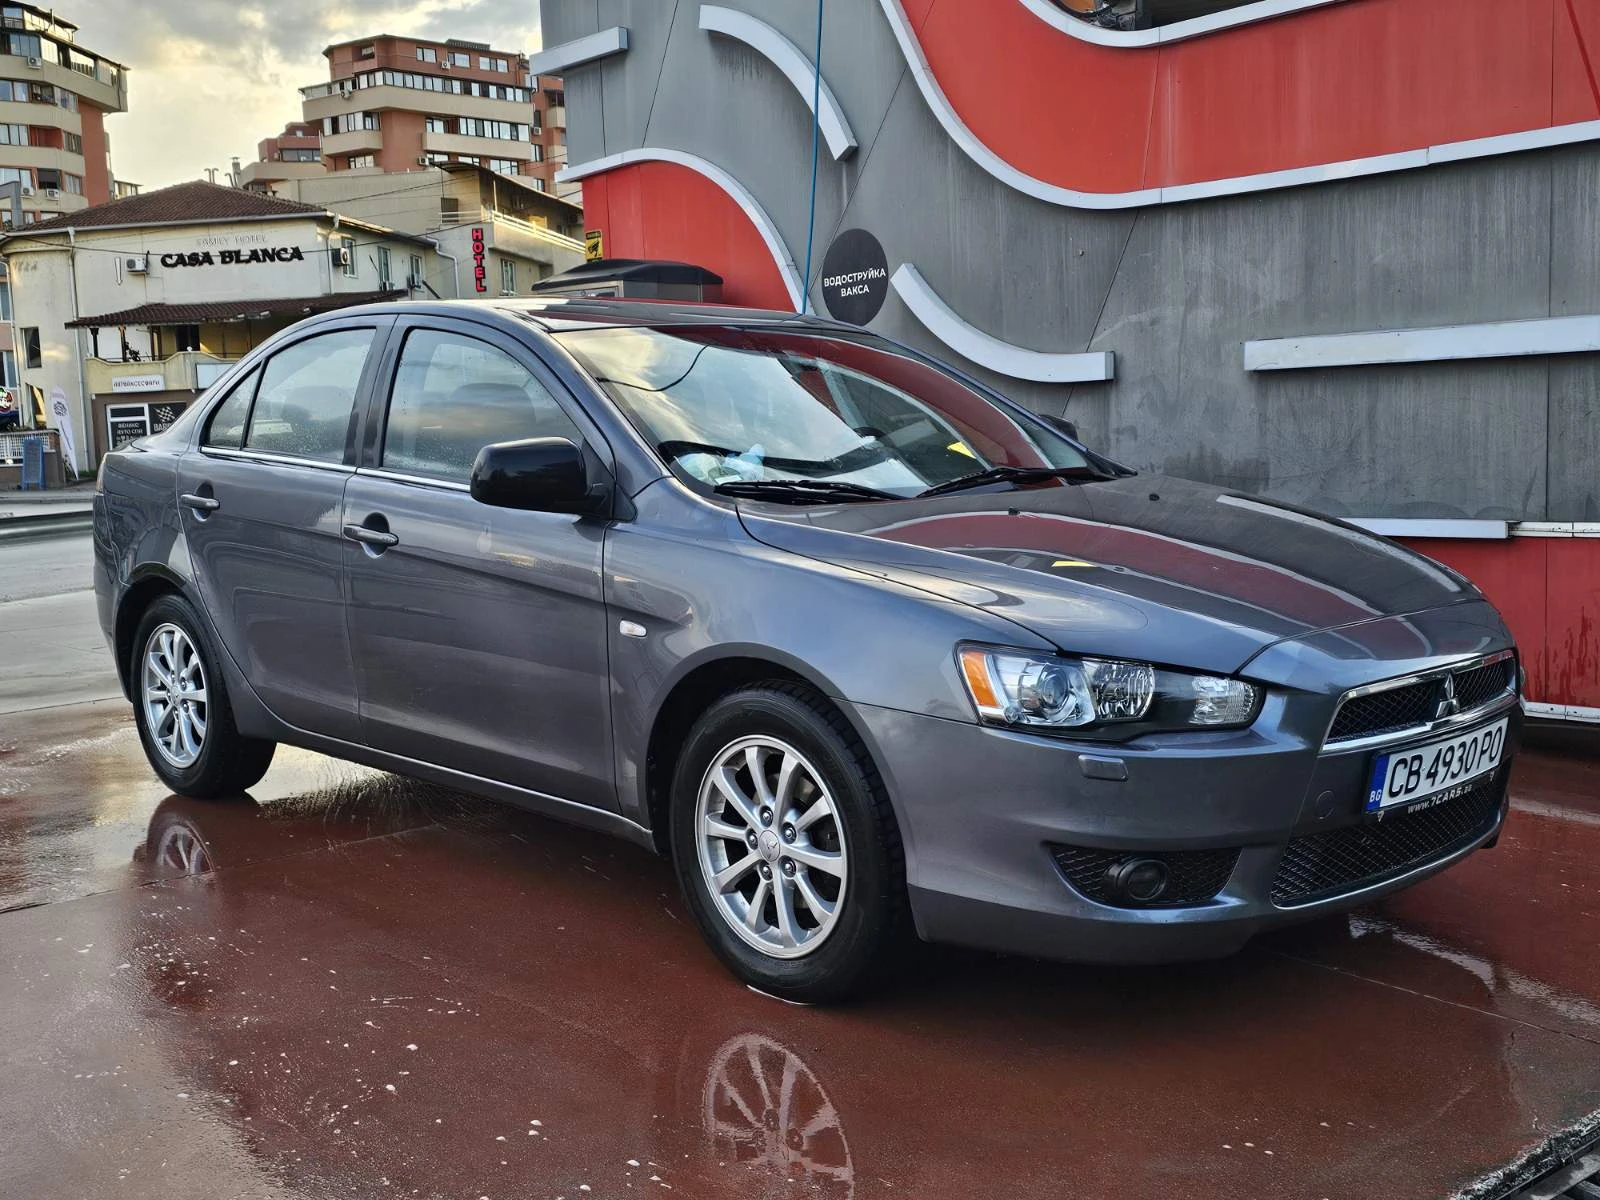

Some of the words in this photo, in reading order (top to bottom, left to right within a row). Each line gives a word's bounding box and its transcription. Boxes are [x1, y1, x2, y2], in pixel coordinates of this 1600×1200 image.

[234, 233, 268, 245] HOTEL
[160, 251, 215, 268] CASA
[218, 246, 304, 265] BLANCA
[472, 228, 487, 292] HOTEL
[824, 267, 886, 287] ВОДОСТРУЙКА
[841, 284, 870, 297] ВАКСА
[1388, 754, 1423, 798] CB
[1426, 736, 1478, 788] 4930
[1369, 789, 1383, 803] BG
